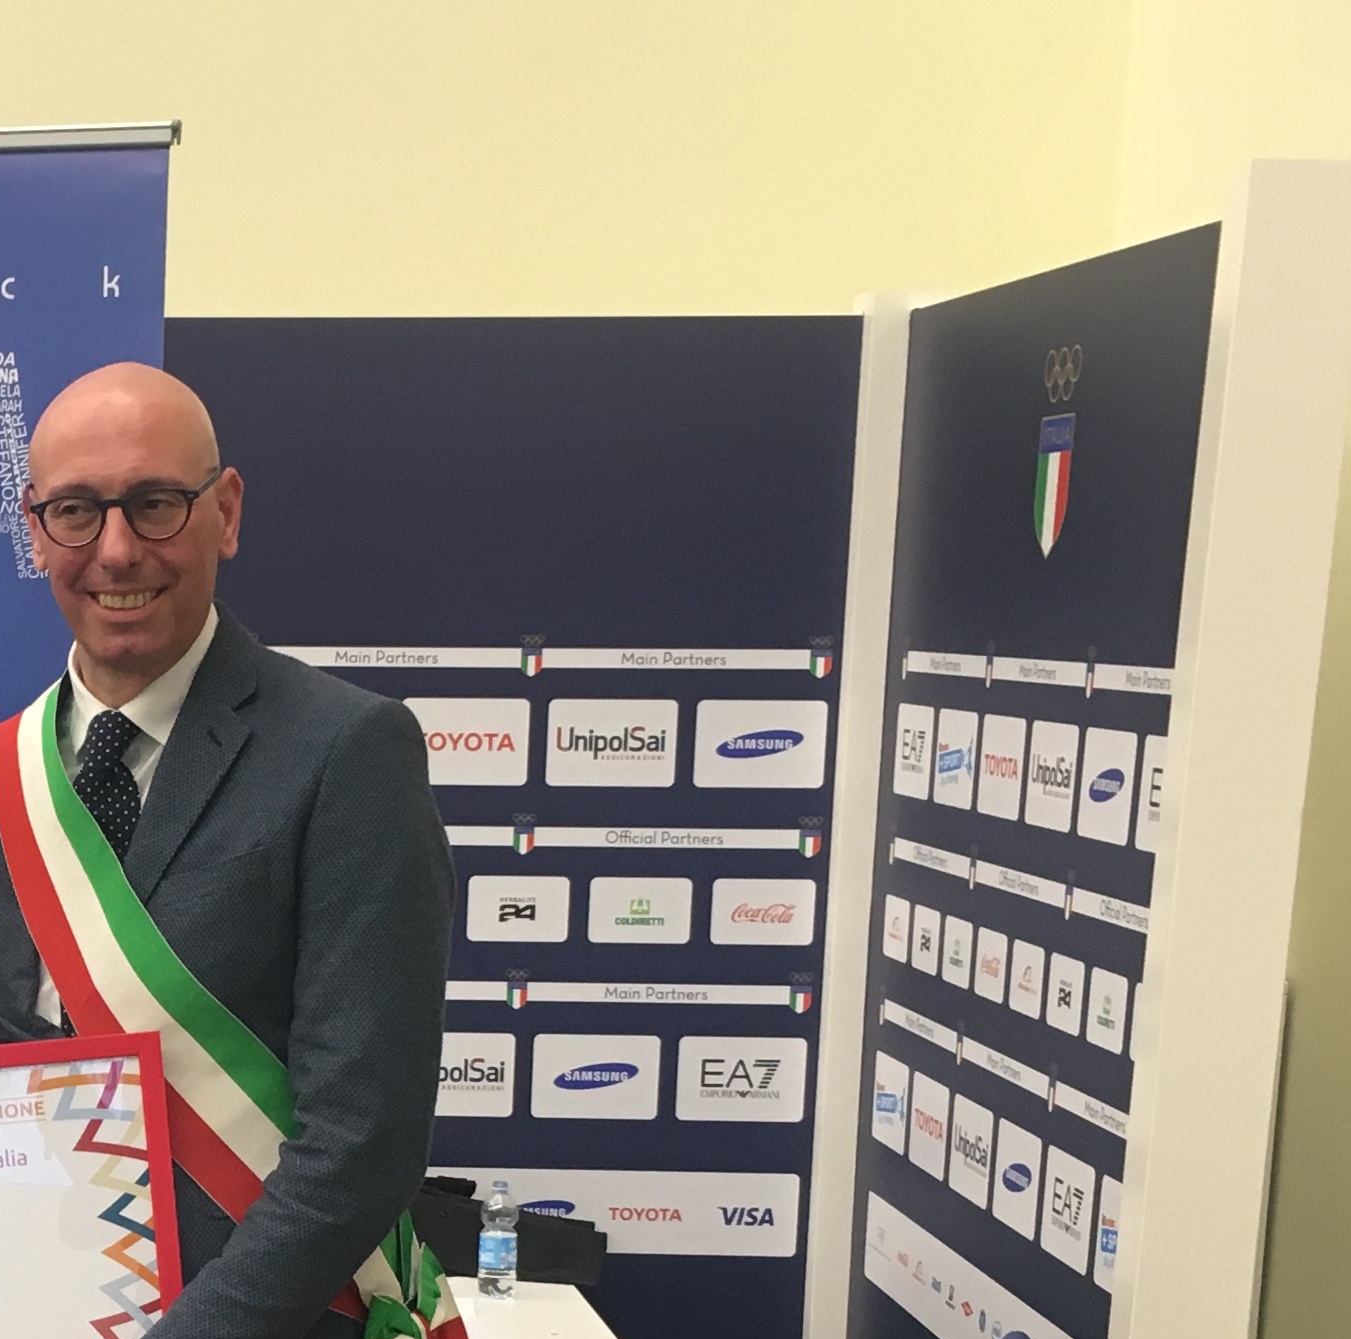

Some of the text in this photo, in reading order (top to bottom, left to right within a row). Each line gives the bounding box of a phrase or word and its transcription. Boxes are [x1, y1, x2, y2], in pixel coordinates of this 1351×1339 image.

[9, 514, 27, 579] SALVATORE
[335, 650, 438, 664] Main Partners
[621, 652, 727, 666] Main Partners
[556, 726, 667, 760] UnipolSai
[726, 738, 795, 750] SAMSUNG
[984, 753, 1018, 780] TOYOTA
[605, 830, 724, 846] Official Partners
[498, 903, 536, 923] 24
[614, 917, 665, 926] COLDIRETTI
[604, 986, 708, 1001] Main Partners
[439, 1057, 505, 1083] olSai
[564, 1070, 630, 1082] SAMSUNG
[700, 1058, 782, 1089] EA7
[914, 1107, 944, 1142] TOYOTA
[608, 1206, 775, 1226] TOYOTA VISA
